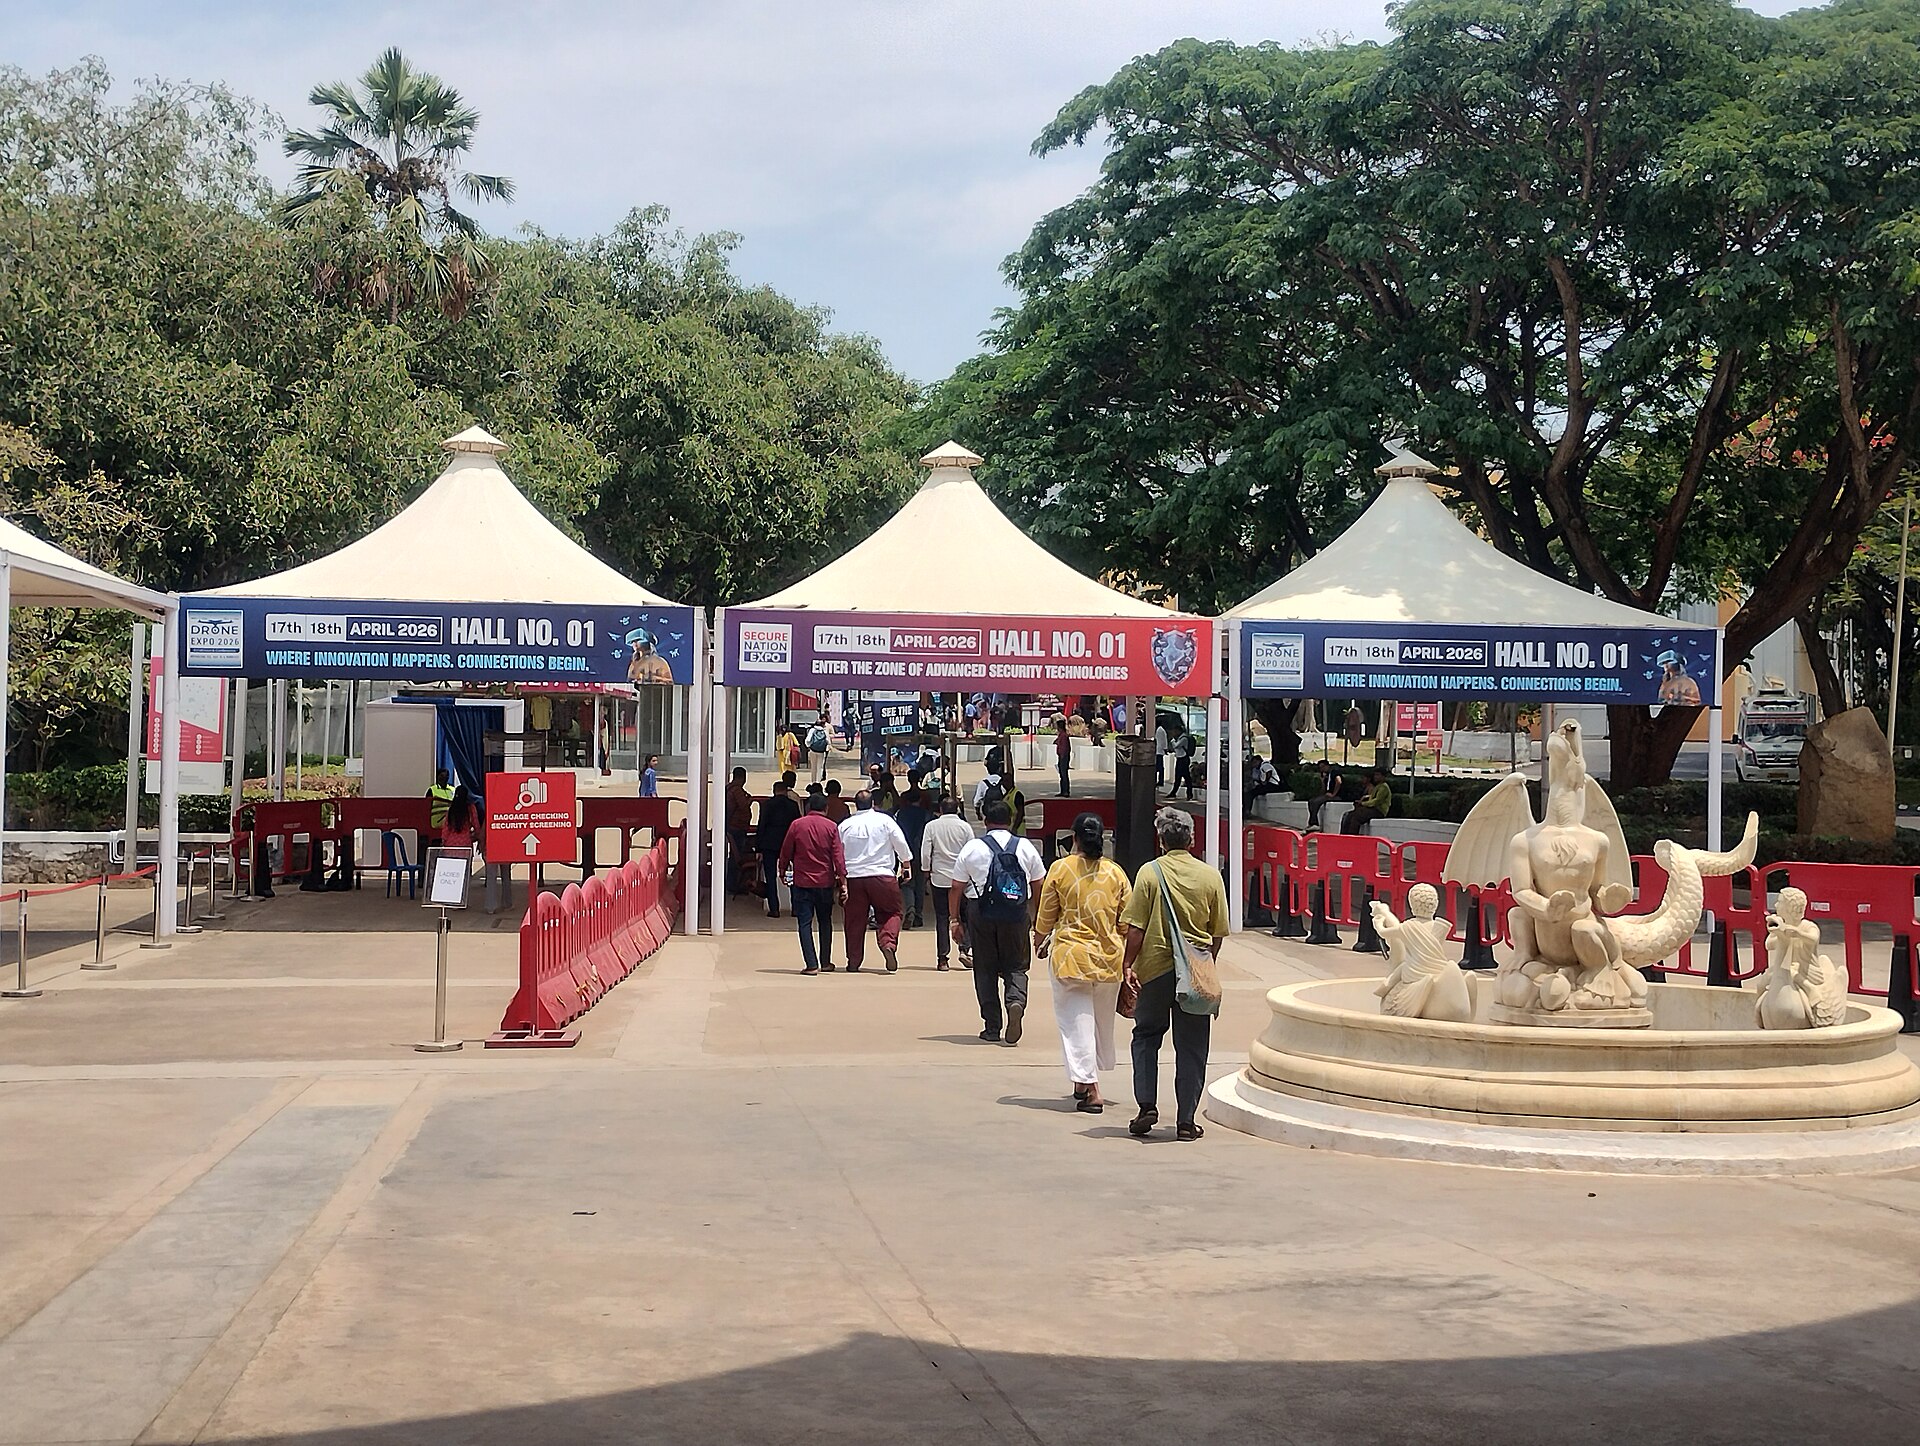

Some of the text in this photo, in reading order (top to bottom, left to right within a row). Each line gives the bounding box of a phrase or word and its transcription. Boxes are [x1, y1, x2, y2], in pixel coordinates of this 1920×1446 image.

[190, 625, 239, 635] DRONE
[271, 622, 438, 637] 17th 18th APRIL 2026
[451, 618, 595, 647] HALL NO. 01
[190, 638, 240, 646] EXPO 2026
[744, 631, 788, 642] SECURE
[818, 633, 977, 649] 17th 18th APRIL 2026
[744, 642, 787, 651] NATION
[988, 629, 1126, 659] HALL NO. 01
[749, 652, 781, 662] EXPO
[1255, 648, 1300, 658] DRONE
[1329, 645, 1483, 660] 17th 18th APRIL 2026
[1494, 641, 1629, 669] HALL NO. 01
[265, 650, 589, 671] WHERE INNOVATION HAPPENS. CONNECTIONS BEGIN.
[1255, 660, 1278, 668] EXPO
[811, 660, 1129, 681] ENTER THE ZONE OF ADVANCED SECURITY TECHNOLOGIES
[1324, 673, 1623, 692] WHERE INNOVATION HAPPENS. CONNECTIONS BEGIN.
[881, 705, 913, 718] SEE THE
[888, 716, 905, 726] UAV
[530, 812, 570, 820] CHECKING
[491, 822, 528, 830] SECURITY
